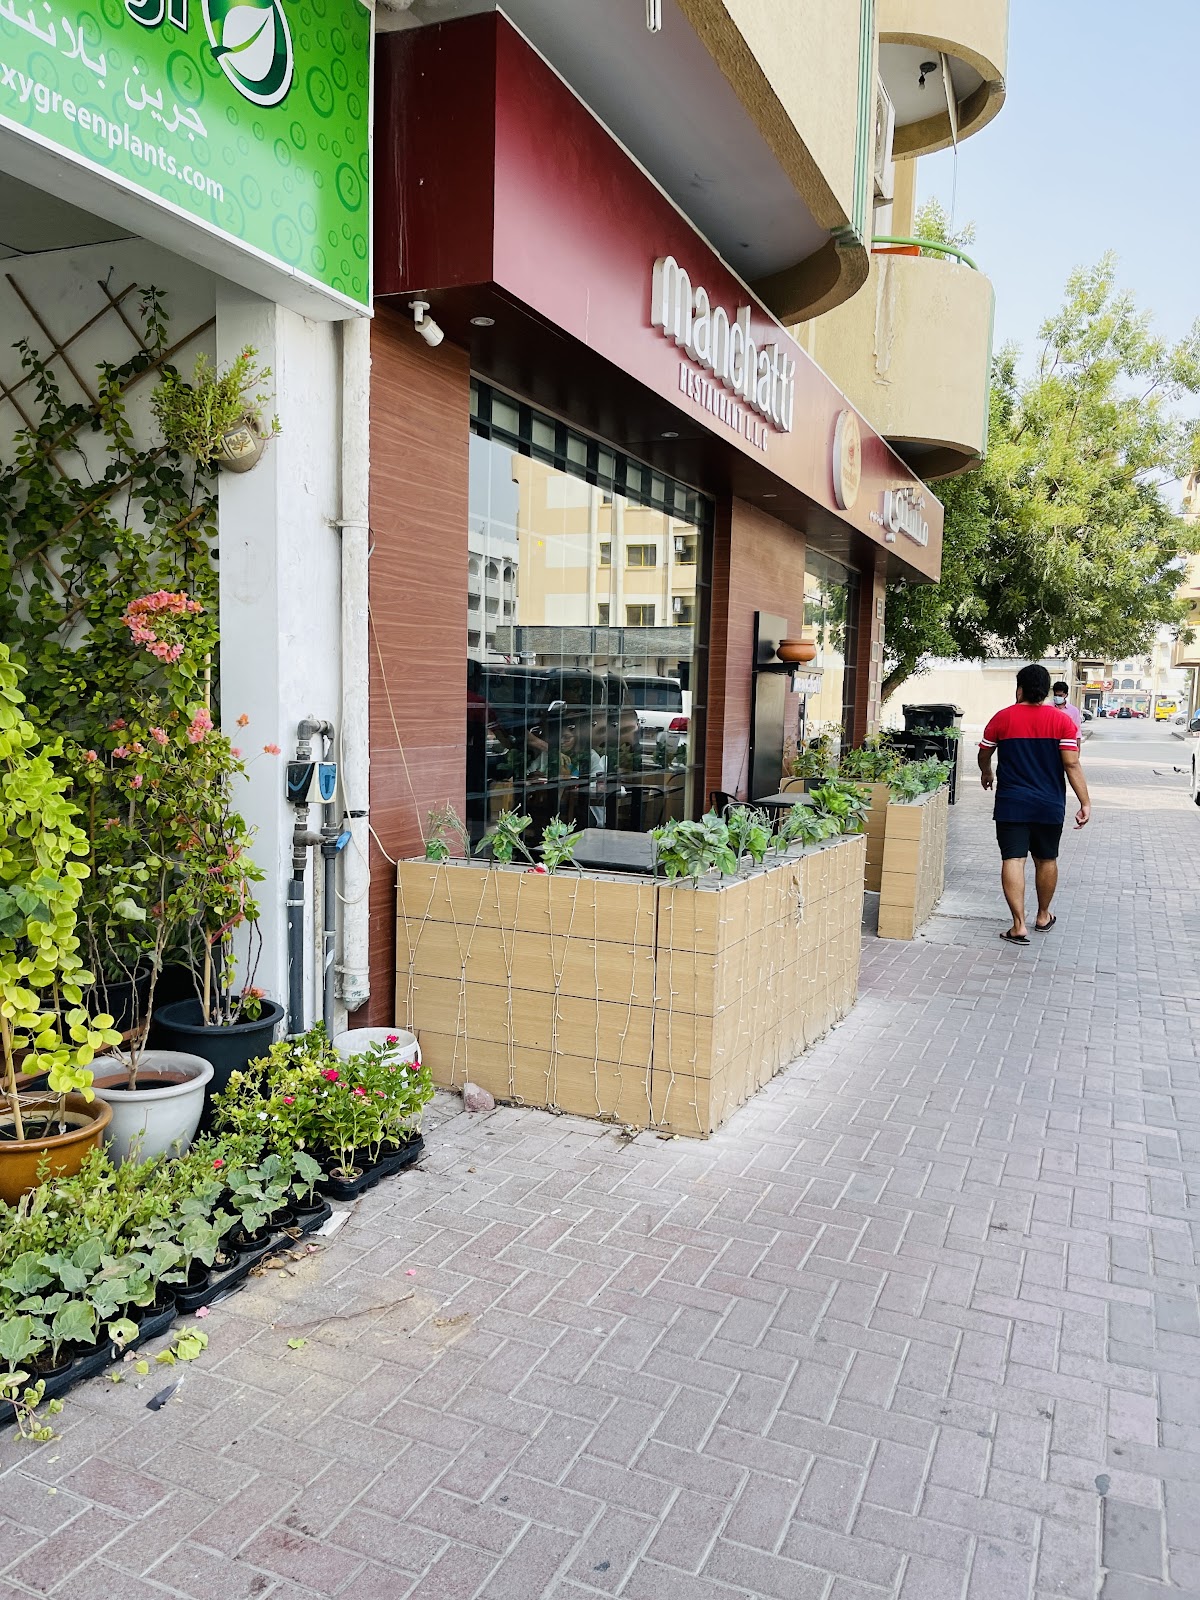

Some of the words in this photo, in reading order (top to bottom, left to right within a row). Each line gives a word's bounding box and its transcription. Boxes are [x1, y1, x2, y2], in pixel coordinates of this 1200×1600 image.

[124, 65, 208, 141] جرين
[652, 255, 796, 433] manchatti
[679, 362, 743, 434] RESTAURANT
